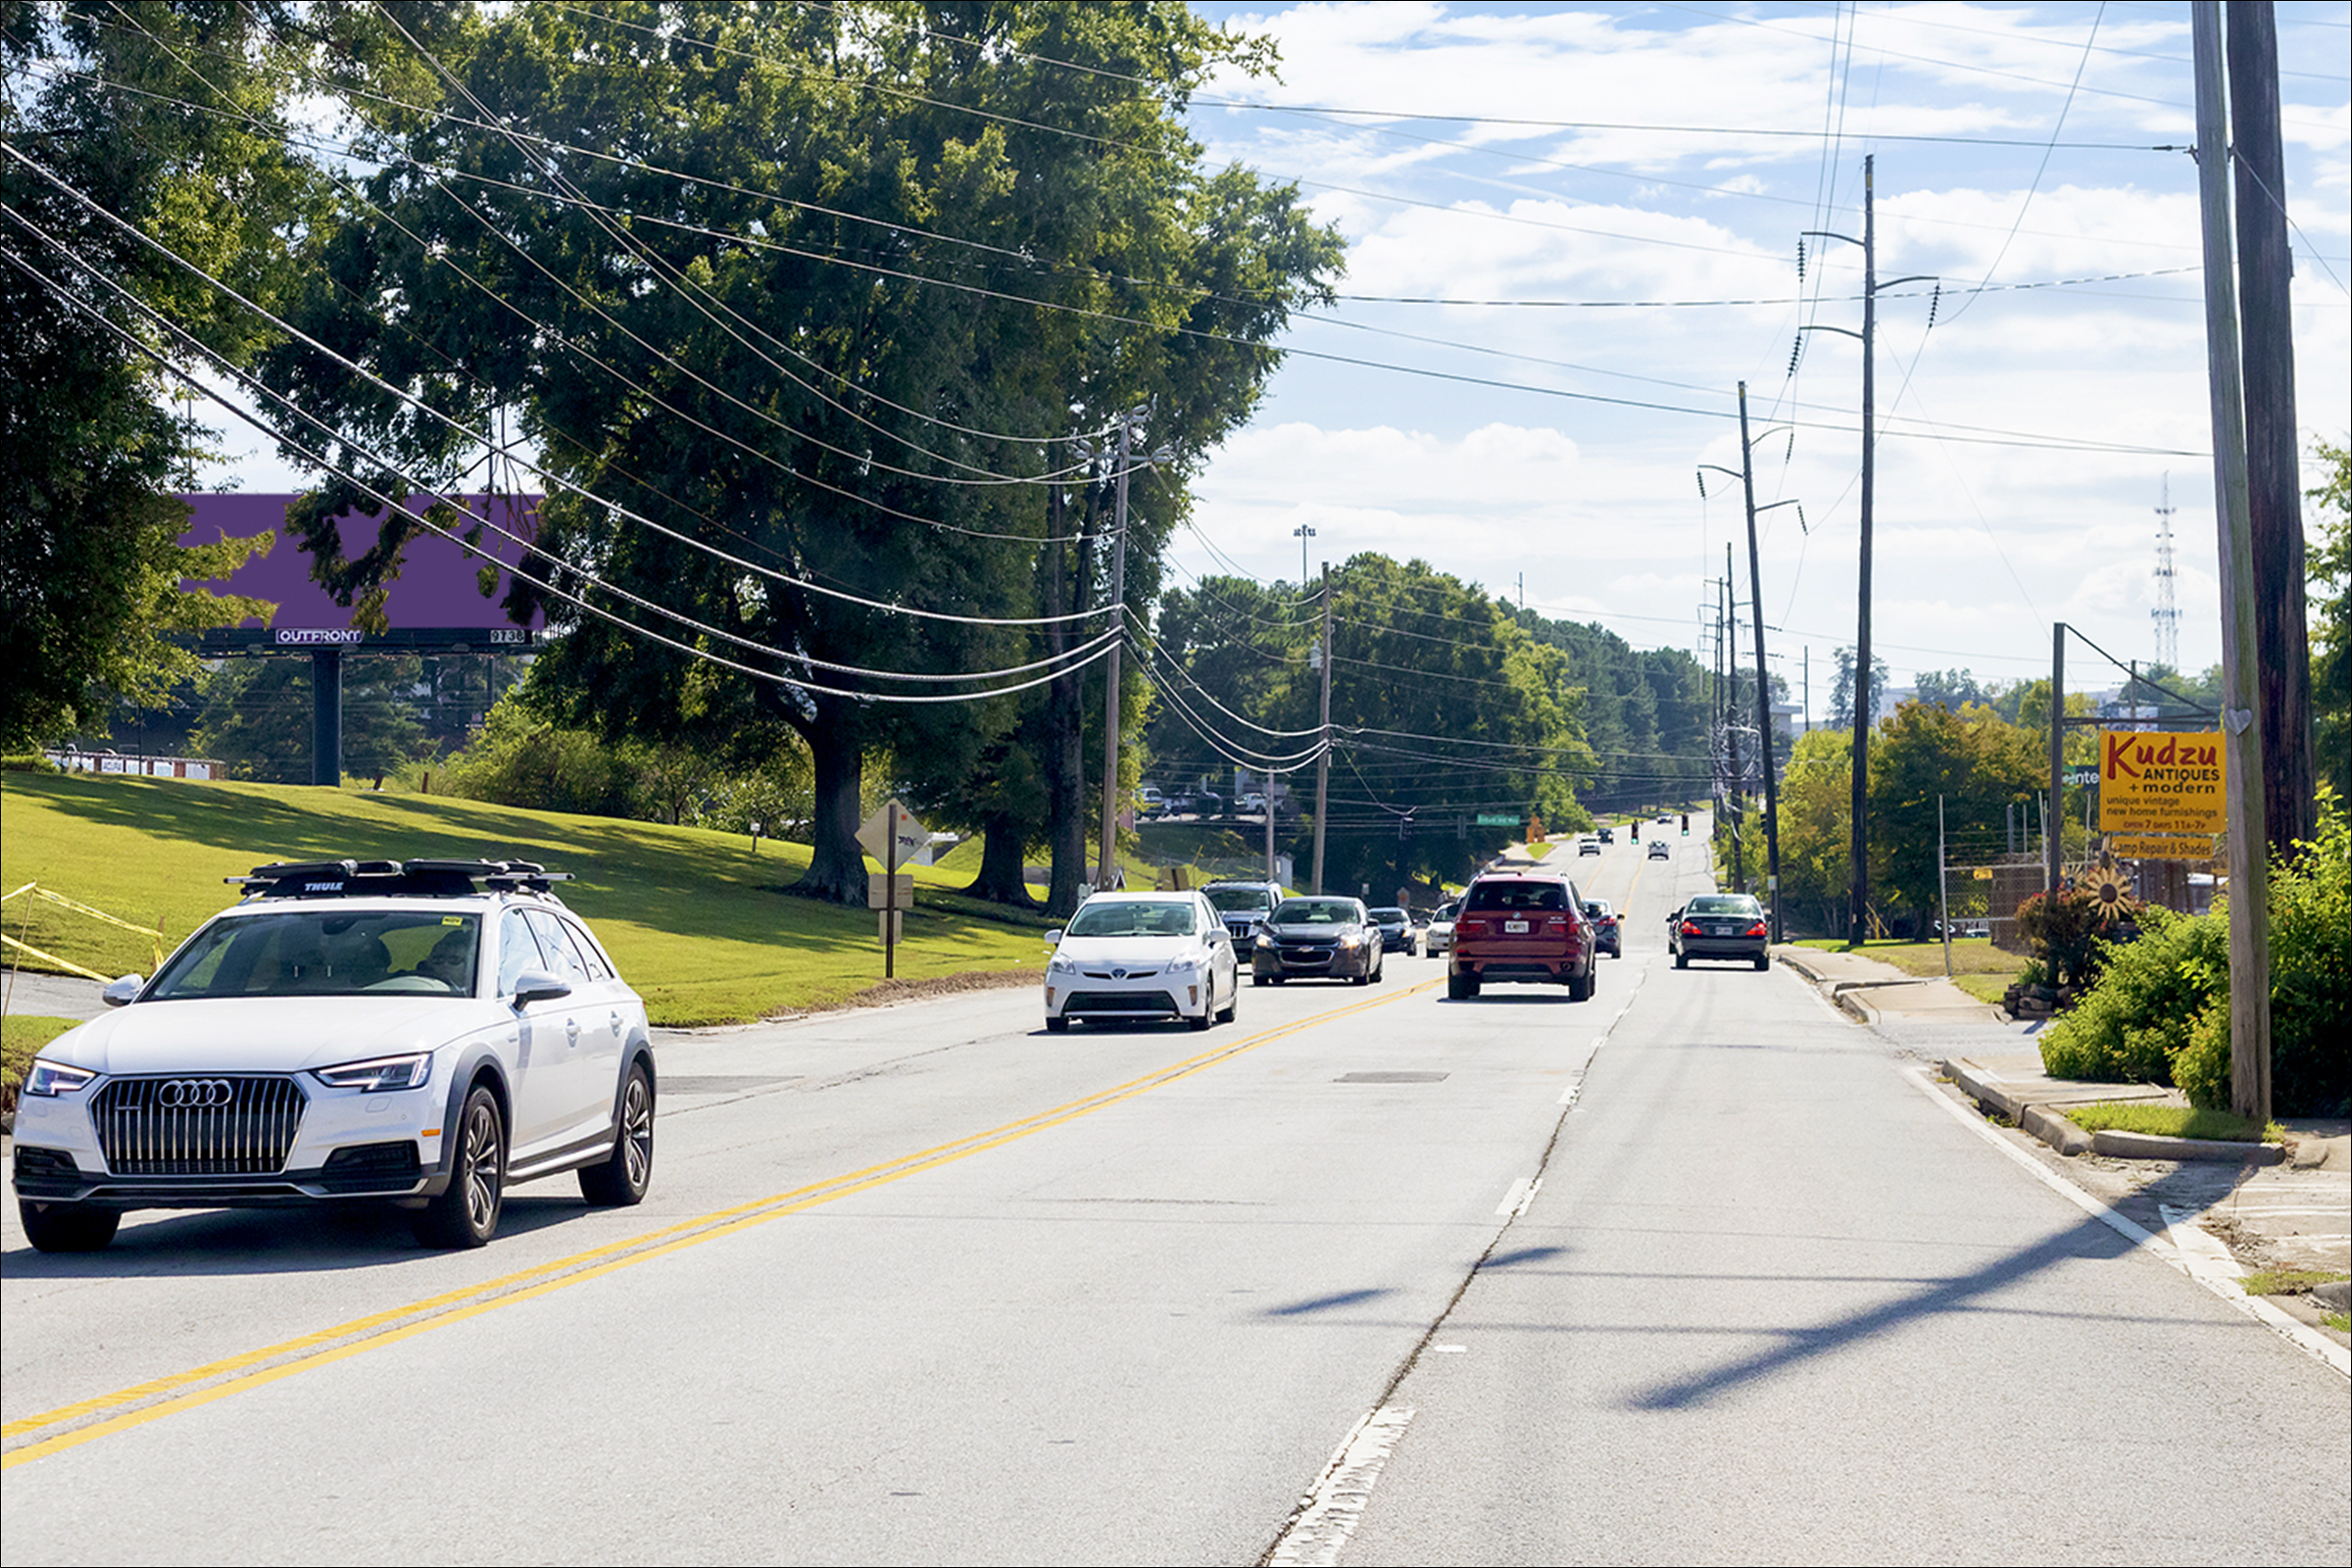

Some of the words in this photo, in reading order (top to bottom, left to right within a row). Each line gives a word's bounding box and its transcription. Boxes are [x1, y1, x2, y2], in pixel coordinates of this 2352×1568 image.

[280, 630, 361, 642] OUTFRONT
[2107, 734, 2217, 780] Kudzu
[2143, 768, 2220, 782] ANTIQUES
[2143, 782, 2215, 794] modern
[2107, 796, 2140, 807] unique
[2143, 796, 2180, 808] vintage
[2130, 807, 2157, 815] home
[2160, 808, 2218, 819] furnishings
[2145, 819, 2151, 829] 7
[2115, 843, 2137, 856] amp
[2139, 842, 2168, 857] Repair
[2179, 842, 2211, 856] Shades
[305, 882, 343, 891] THULE
